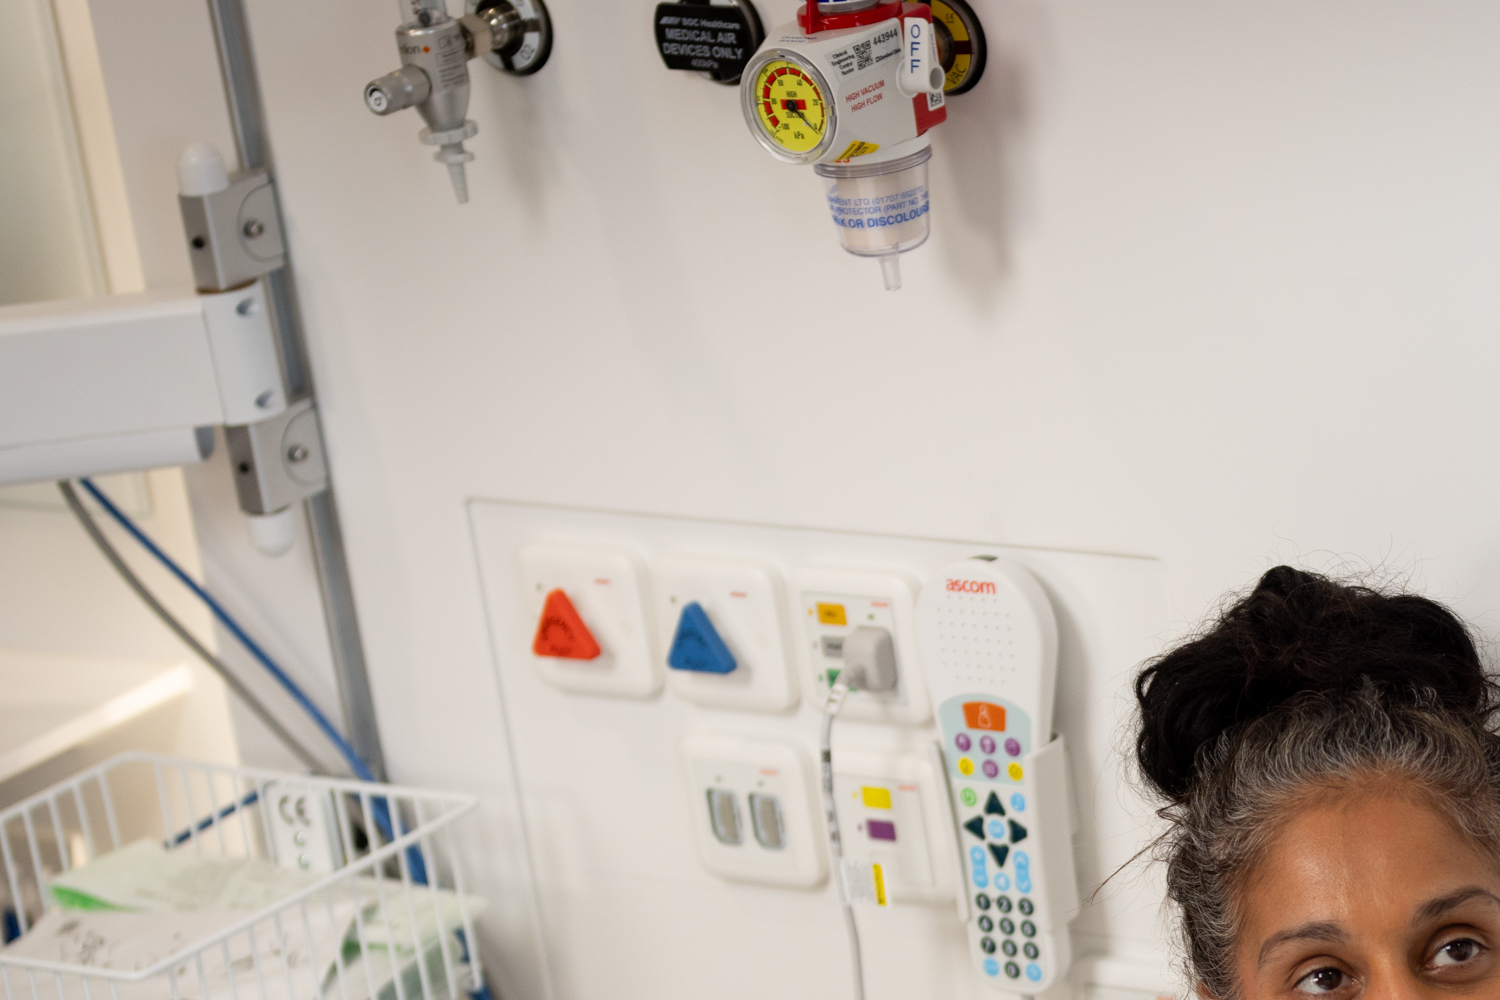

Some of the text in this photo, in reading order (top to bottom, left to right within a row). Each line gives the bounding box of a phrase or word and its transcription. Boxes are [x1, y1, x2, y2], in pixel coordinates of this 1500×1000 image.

[700, 19, 741, 30] Healthcare
[665, 27, 737, 44] MEDICAL AIR
[873, 28, 898, 46] 443944
[662, 42, 743, 59] DEVICES ONLY
[832, 49, 848, 59] Clinical
[910, 24, 921, 74] OFF
[831, 54, 856, 66] Engineering
[947, 63, 966, 85] VAC
[845, 79, 885, 103] HIGH VACUUM
[851, 92, 883, 113] HIGH FLOW
[793, 131, 805, 140] kPa
[883, 201, 907, 213] (PART
[908, 197, 919, 206] NO
[848, 218, 864, 229] OR
[945, 578, 997, 595] ascom
